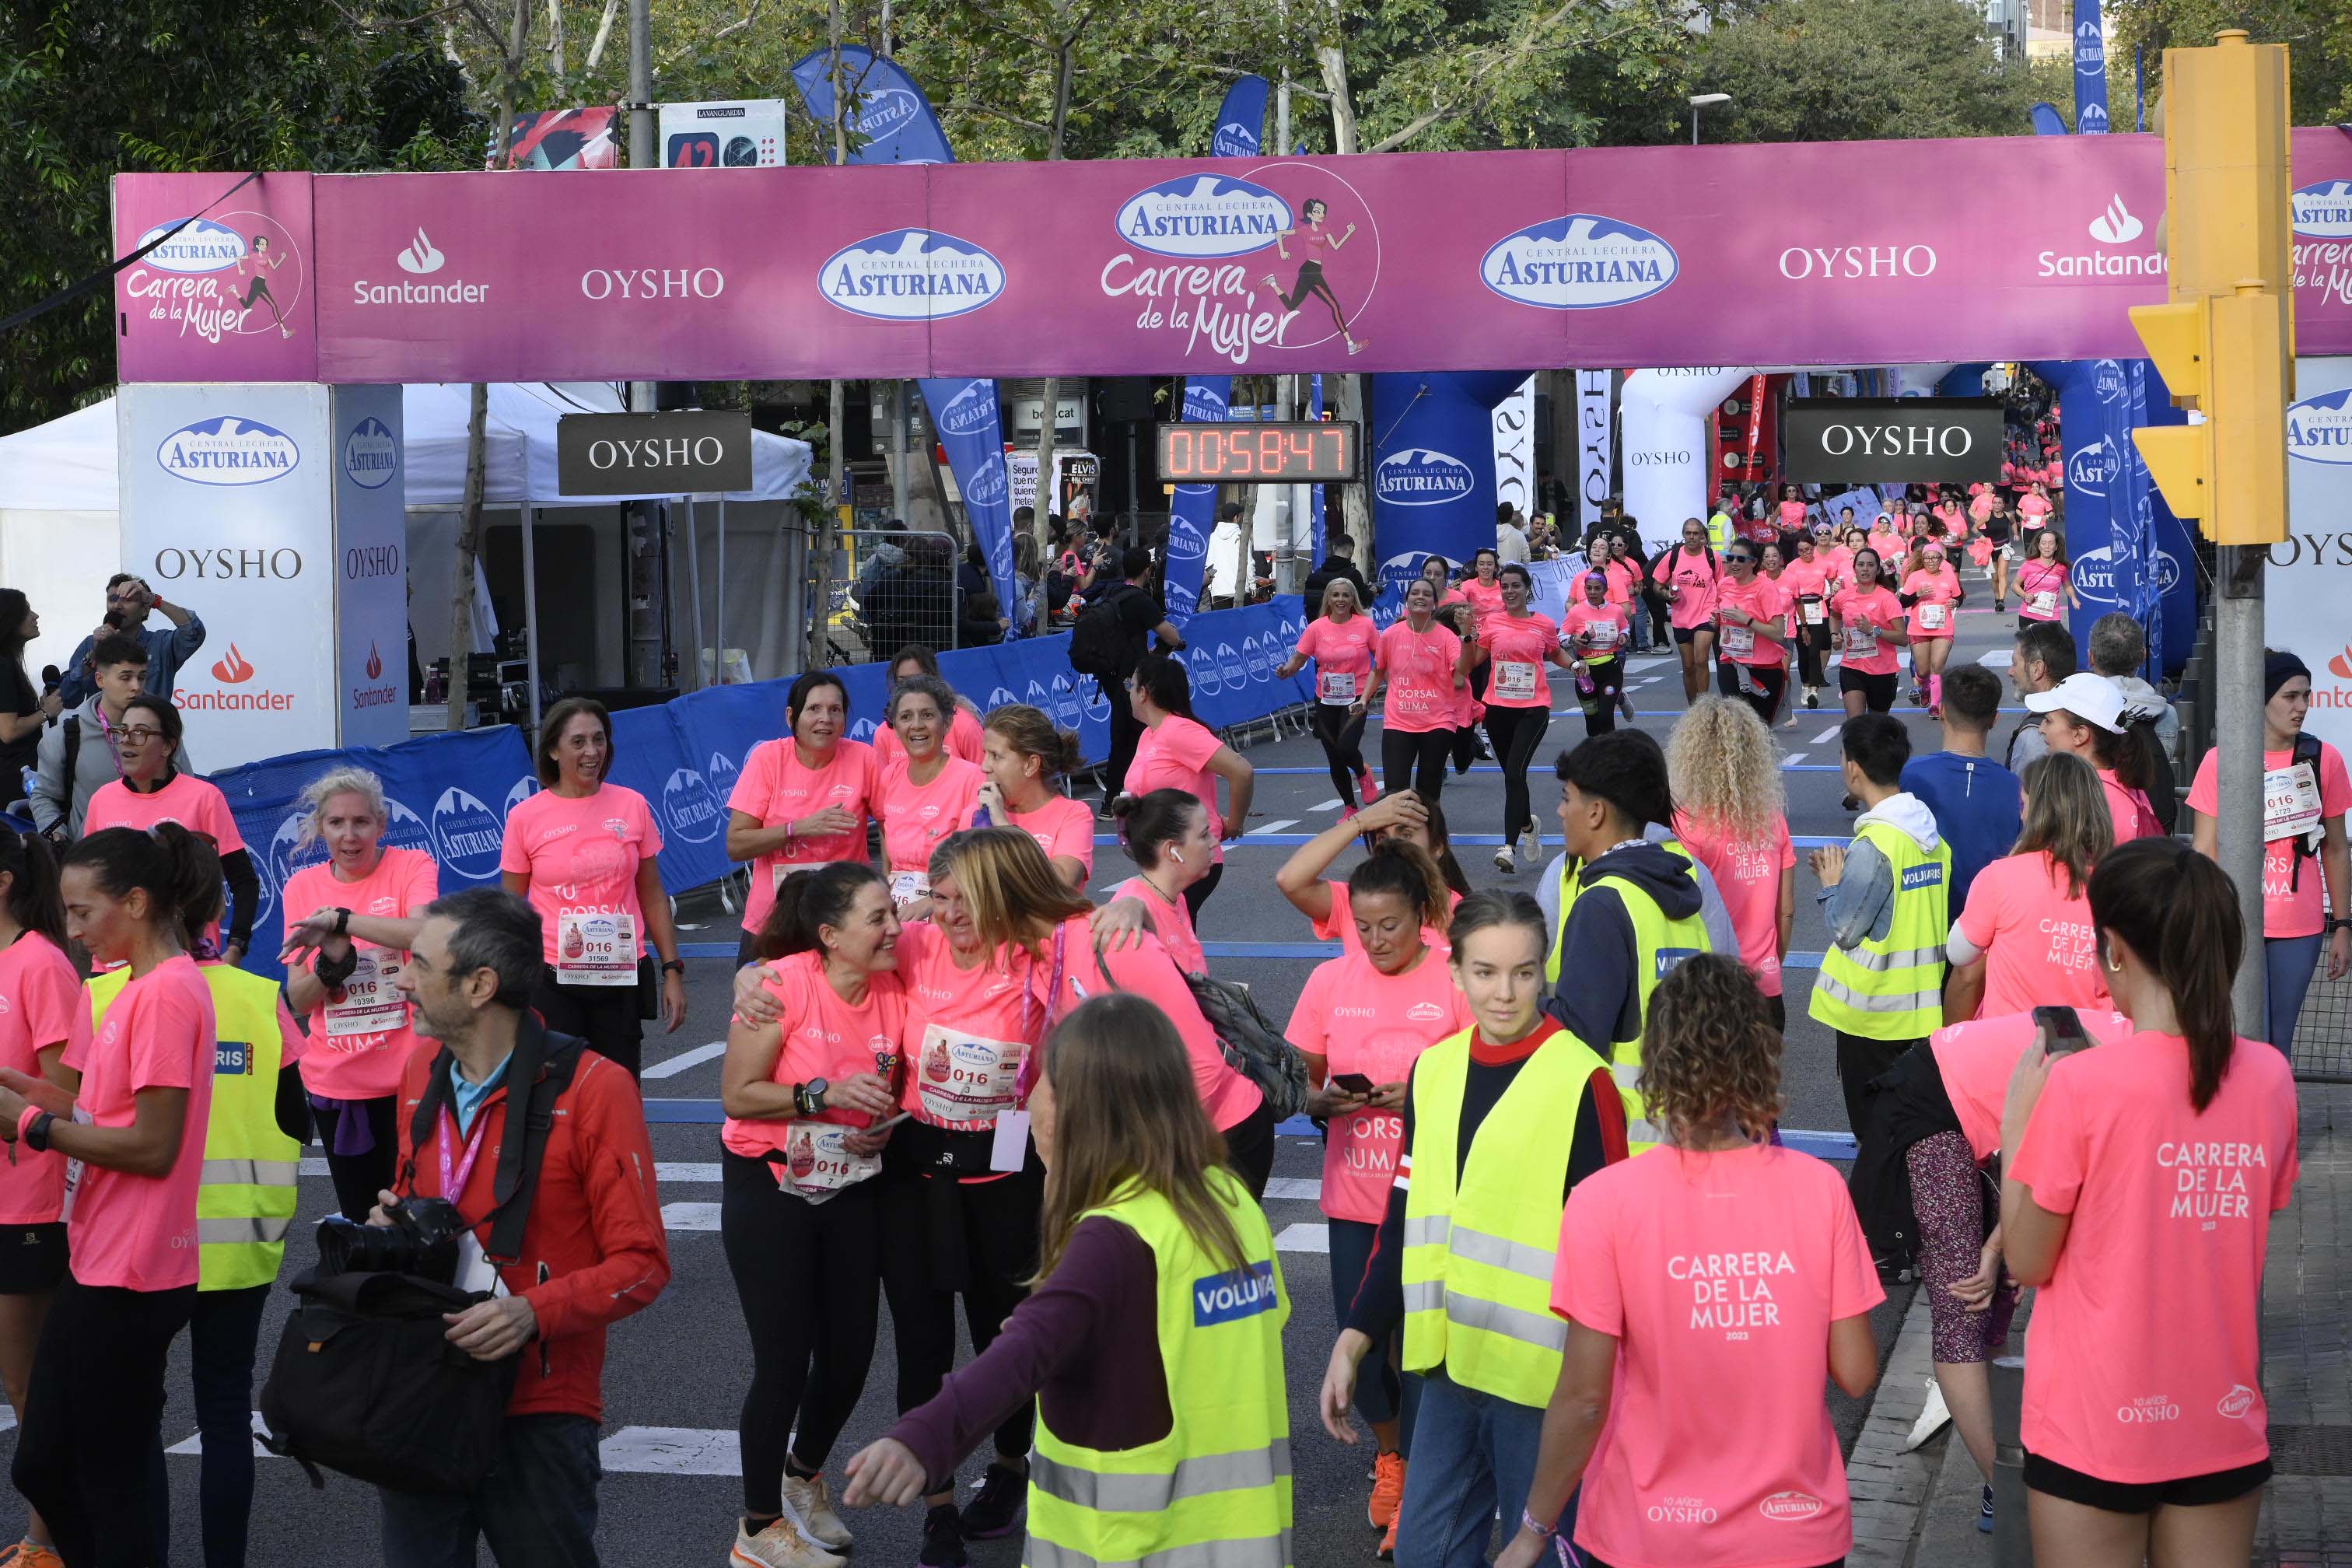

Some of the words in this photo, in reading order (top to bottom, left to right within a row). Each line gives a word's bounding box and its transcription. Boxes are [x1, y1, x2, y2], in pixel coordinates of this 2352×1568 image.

[1157, 202, 1213, 211] CENTRAL
[1218, 201, 1274, 211] LECHERA
[1129, 205, 1279, 237] ASTURIANA
[1526, 247, 1588, 257] CENTRAL
[1594, 245, 1657, 255] LECHERA
[861, 260, 922, 270] CENTRAL
[926, 259, 985, 270] LECHERA
[1496, 250, 1664, 286] ASTURIANA
[1779, 244, 1937, 279] OYSHO
[2038, 250, 2170, 278] Santand
[127, 269, 218, 298] Carrera
[581, 268, 725, 300] OYSHO
[832, 263, 991, 297] ASTURIANA
[1101, 254, 1246, 297] Carrera
[353, 280, 489, 304] Santander
[149, 298, 166, 320] de
[170, 298, 182, 320] la
[180, 295, 254, 344] Mujer
[1136, 299, 1164, 329] de
[1170, 297, 1188, 329] la
[1185, 291, 1301, 365] Mujer
[1821, 424, 1972, 457] OYSHO
[168, 443, 289, 469] ASTURIANA
[348, 444, 394, 471] ASTURIANA
[588, 436, 724, 470] OYSHO
[1631, 450, 1691, 466] OYSHO
[1071, 464, 1095, 474] ELVIS
[1378, 471, 1467, 493] ASTURIANA
[155, 548, 303, 579] OYSHO
[346, 544, 399, 580] OYSHO
[1399, 677, 1409, 686] TU
[173, 688, 294, 712] Santander
[353, 685, 397, 710] Santander
[1398, 689, 1438, 699] DORSAL
[1398, 701, 1429, 711] SUMA
[2267, 794, 2294, 809] 016
[2274, 807, 2291, 817] 2729
[439, 824, 502, 859] ASTURIANA
[1735, 856, 1749, 868] DE
[1752, 854, 1766, 866] LA
[1734, 865, 1770, 881] MUJER
[553, 884, 576, 901] TU
[2264, 879, 2293, 896] MA
[586, 942, 613, 953] 016
[2052, 935, 2069, 951] DE
[2073, 939, 2093, 954] LA
[348, 981, 377, 995] 016
[354, 997, 376, 1006] 10396
[1334, 1006, 1376, 1018] OYSHO
[334, 1021, 359, 1030] OYSHO
[955, 1048, 995, 1063] ASTURIANA
[953, 1069, 989, 1084] 016
[929, 1087, 954, 1101] CARRERA
[964, 1086, 971, 1094] 3
[925, 1096, 953, 1114] OYSHO
[1344, 1116, 1402, 1139] DORS
[2156, 1142, 2267, 1167] CARRERA
[817, 1160, 849, 1175] 016
[828, 1178, 834, 1186] 7
[2178, 1169, 2207, 1193] DE
[2215, 1168, 2246, 1193] LA
[2170, 1194, 2249, 1219] MUJER
[1668, 1250, 1795, 1280] CARRERA
[1694, 1279, 1728, 1304] DE
[1739, 1277, 1773, 1302] LA
[1690, 1303, 1780, 1329] MUJER
[1726, 1332, 1749, 1341] 2023
[2117, 1403, 2180, 1423] OYSHO
[1663, 1497, 1674, 1507] 10
[1676, 1496, 1703, 1507] AÑOS
[1766, 1502, 1818, 1514] ASTURIANA
[1647, 1506, 1718, 1524] OYSHO
